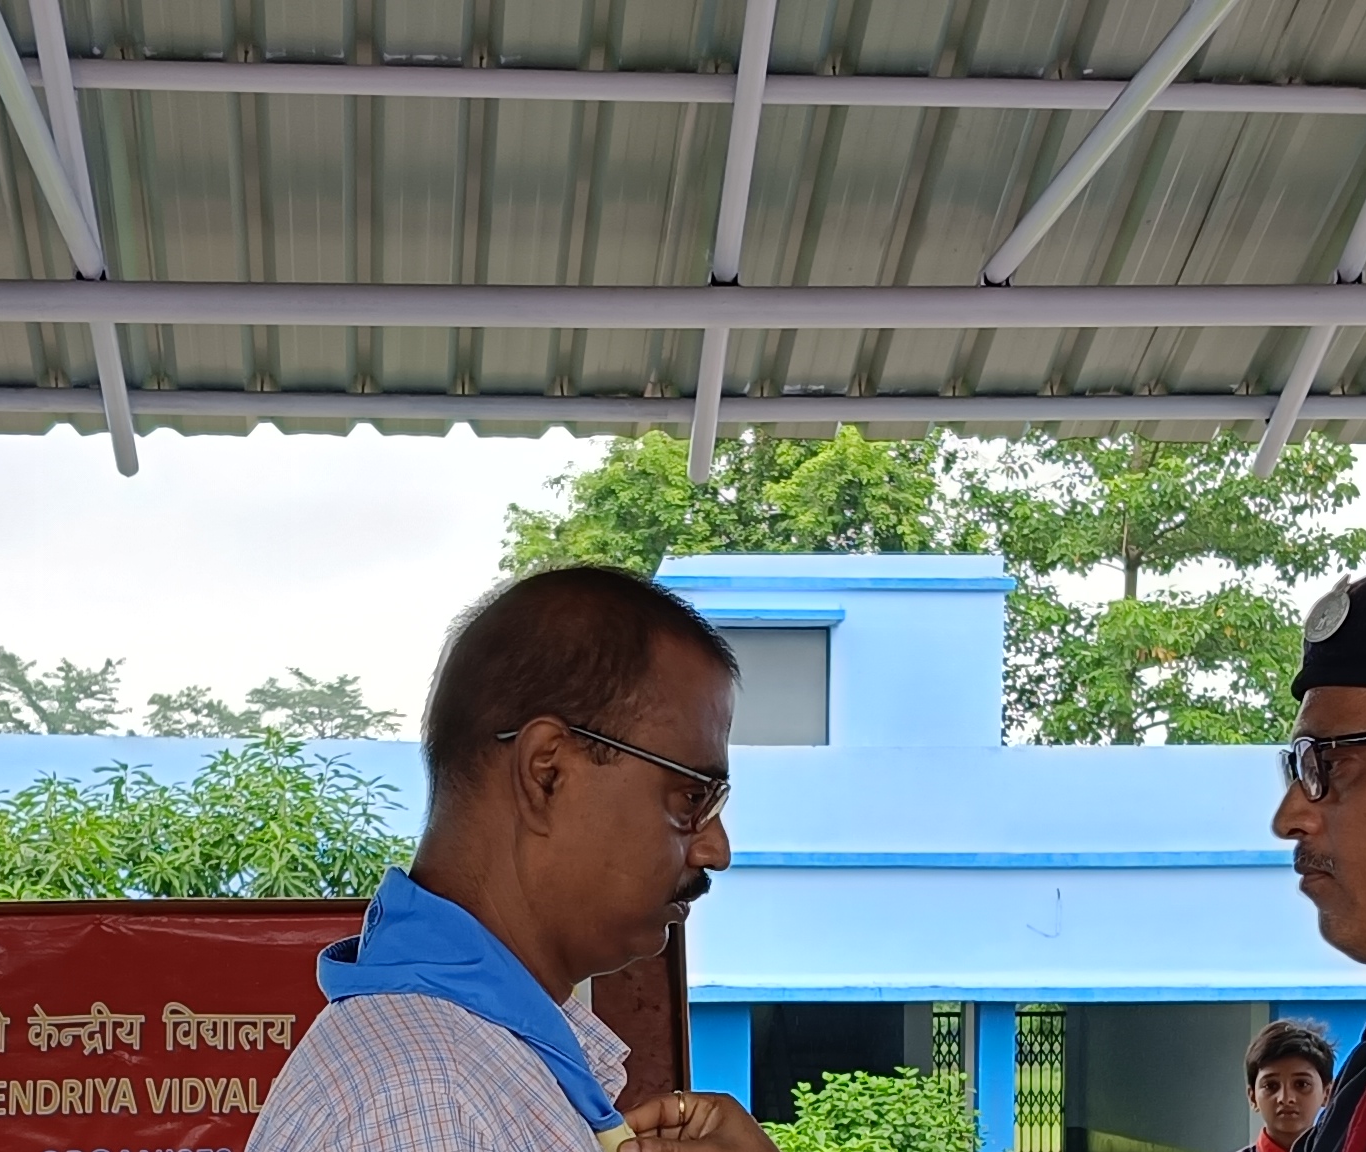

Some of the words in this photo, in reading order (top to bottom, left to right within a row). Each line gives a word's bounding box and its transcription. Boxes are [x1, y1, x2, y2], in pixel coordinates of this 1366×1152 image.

[27, 1002, 145, 1055] केन्द्रीय
[162, 1002, 296, 1050] विद्यालय
[146, 1077, 277, 1114] VIDYAL
